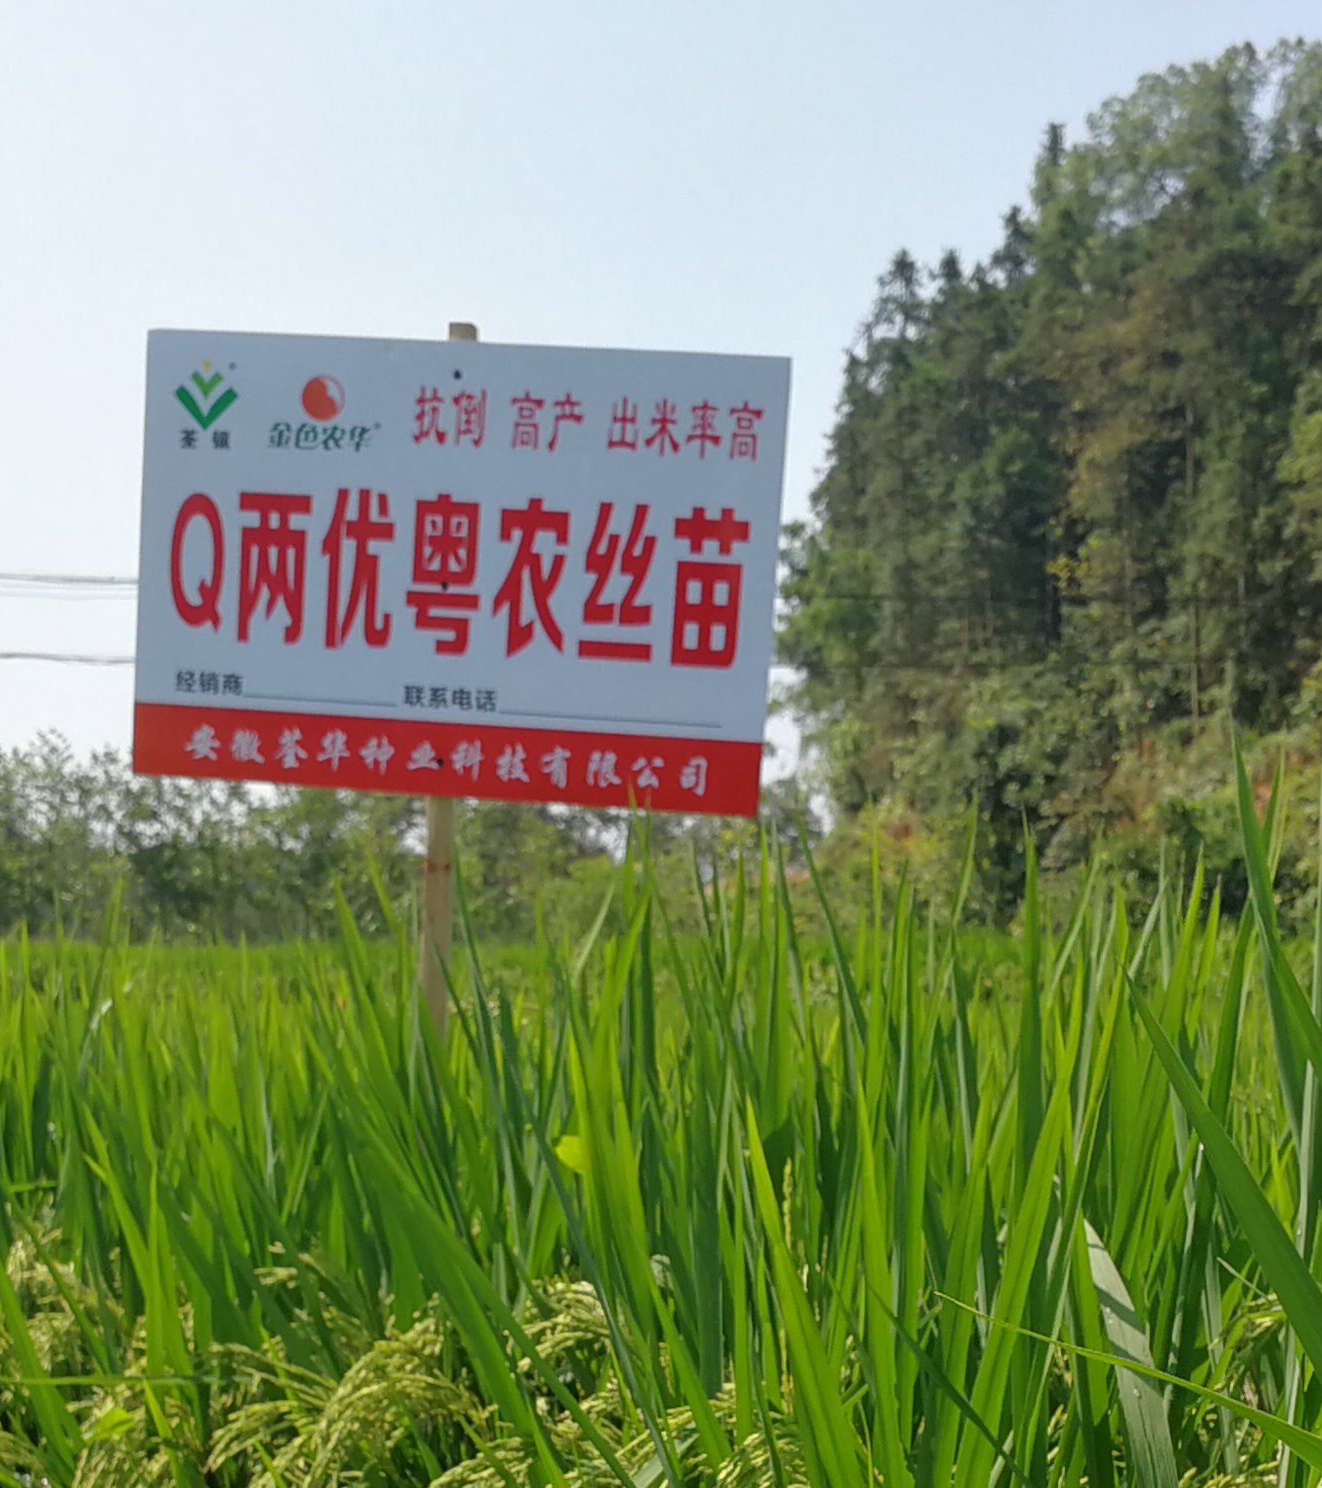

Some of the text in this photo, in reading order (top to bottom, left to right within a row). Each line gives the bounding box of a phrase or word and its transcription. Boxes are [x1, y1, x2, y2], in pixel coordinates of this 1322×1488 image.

[268, 421, 371, 452] 金色农华
[413, 387, 764, 461] 抗倒 高产 出米率高
[169, 487, 751, 669] Q两优粤农丝苗
[176, 670, 243, 696] 经销商
[404, 684, 498, 712] 联系电话
